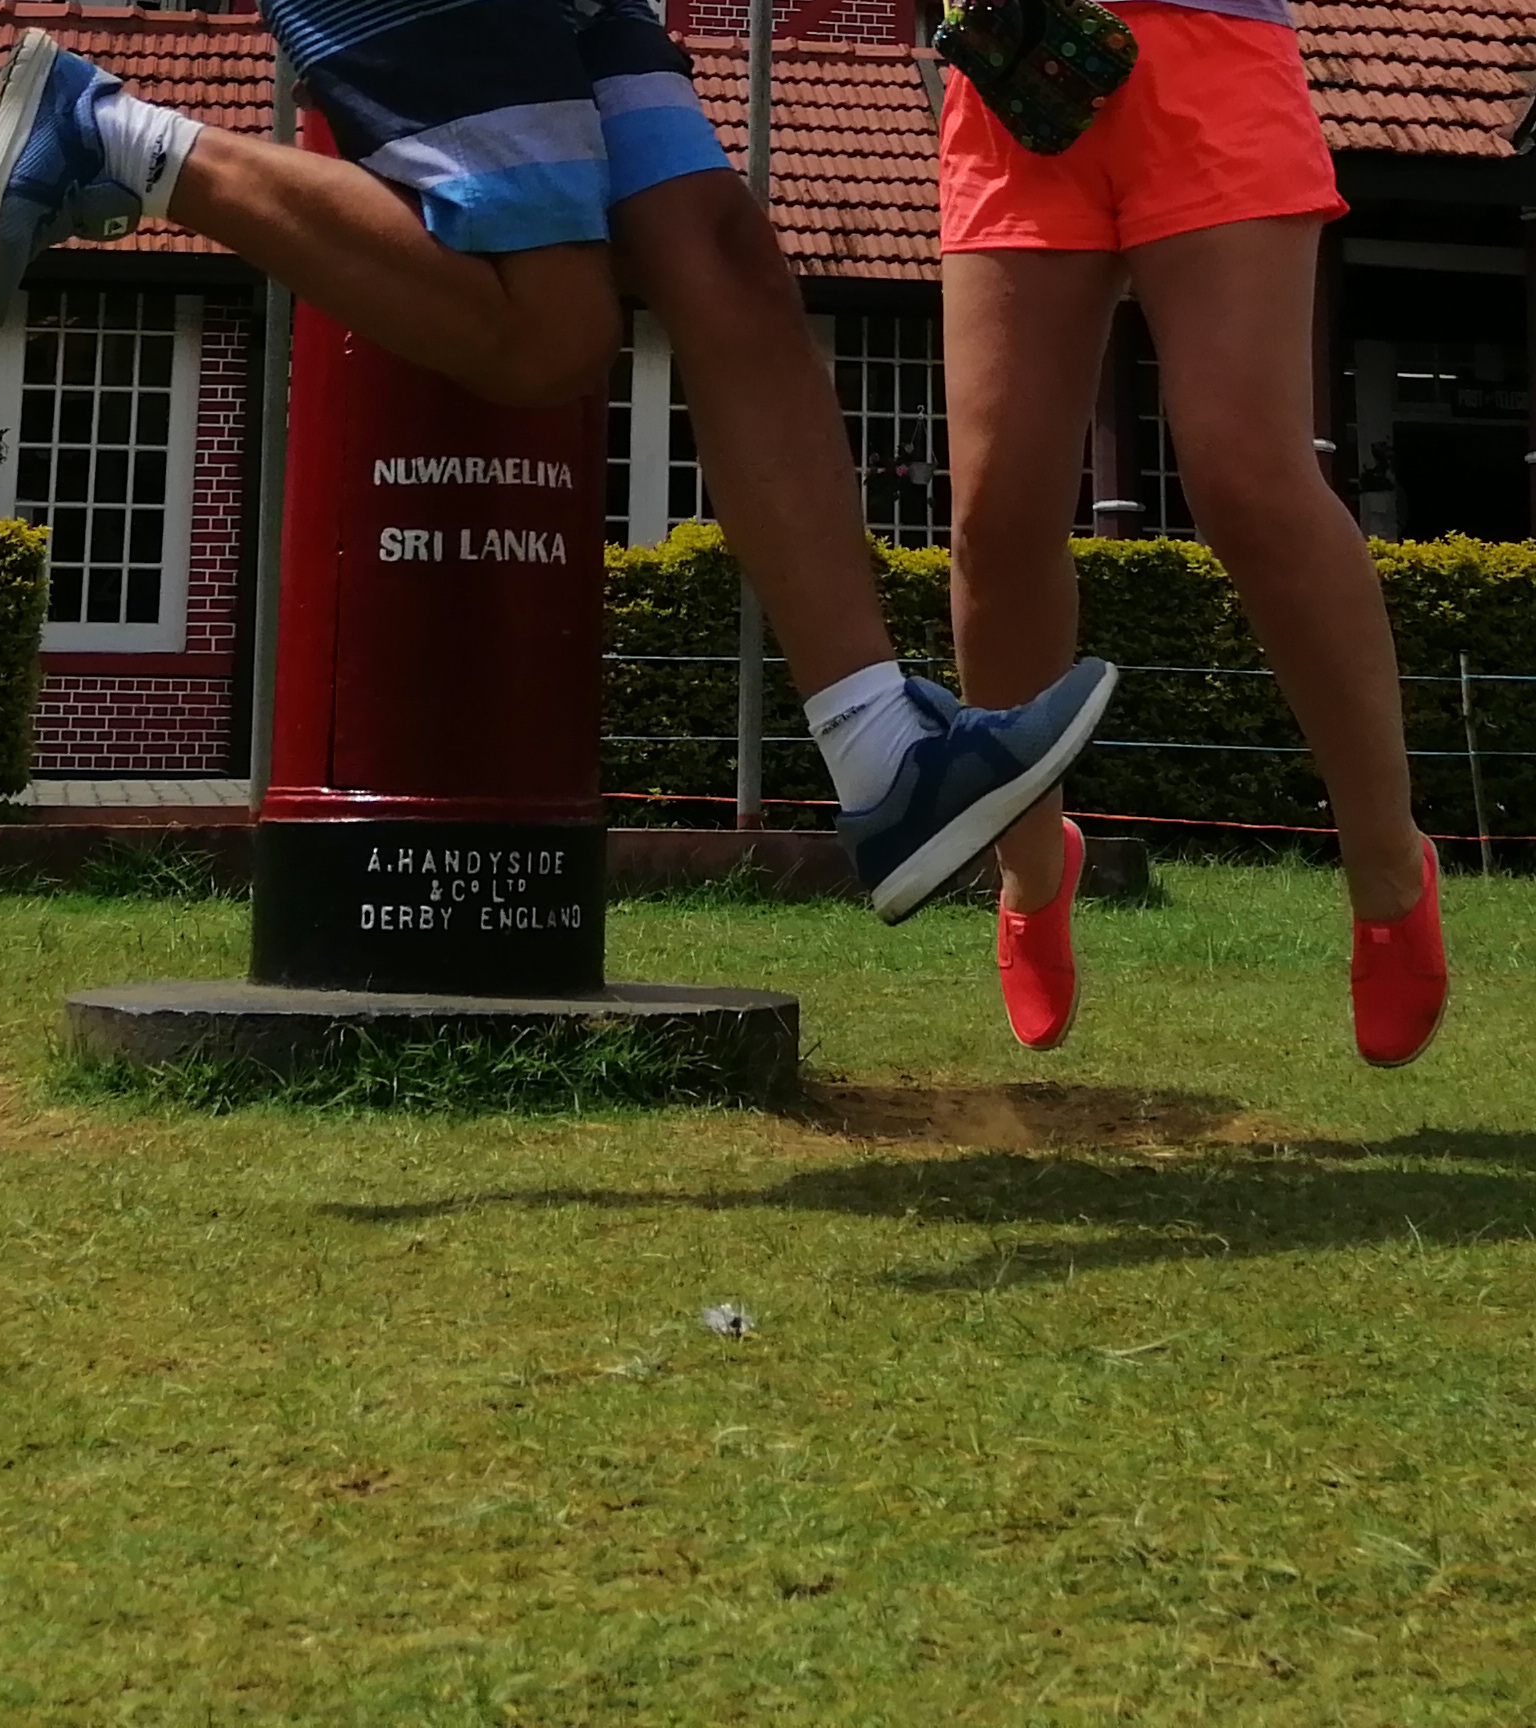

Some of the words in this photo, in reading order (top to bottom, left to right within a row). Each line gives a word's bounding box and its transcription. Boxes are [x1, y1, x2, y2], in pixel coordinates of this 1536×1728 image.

[373, 456, 574, 490] NUWARAELIYA
[379, 527, 443, 563] SRI
[459, 528, 567, 565] LANKA
[429, 879, 444, 903] &
[360, 903, 453, 930] DERBY
[480, 904, 582, 931] ENGLAND
